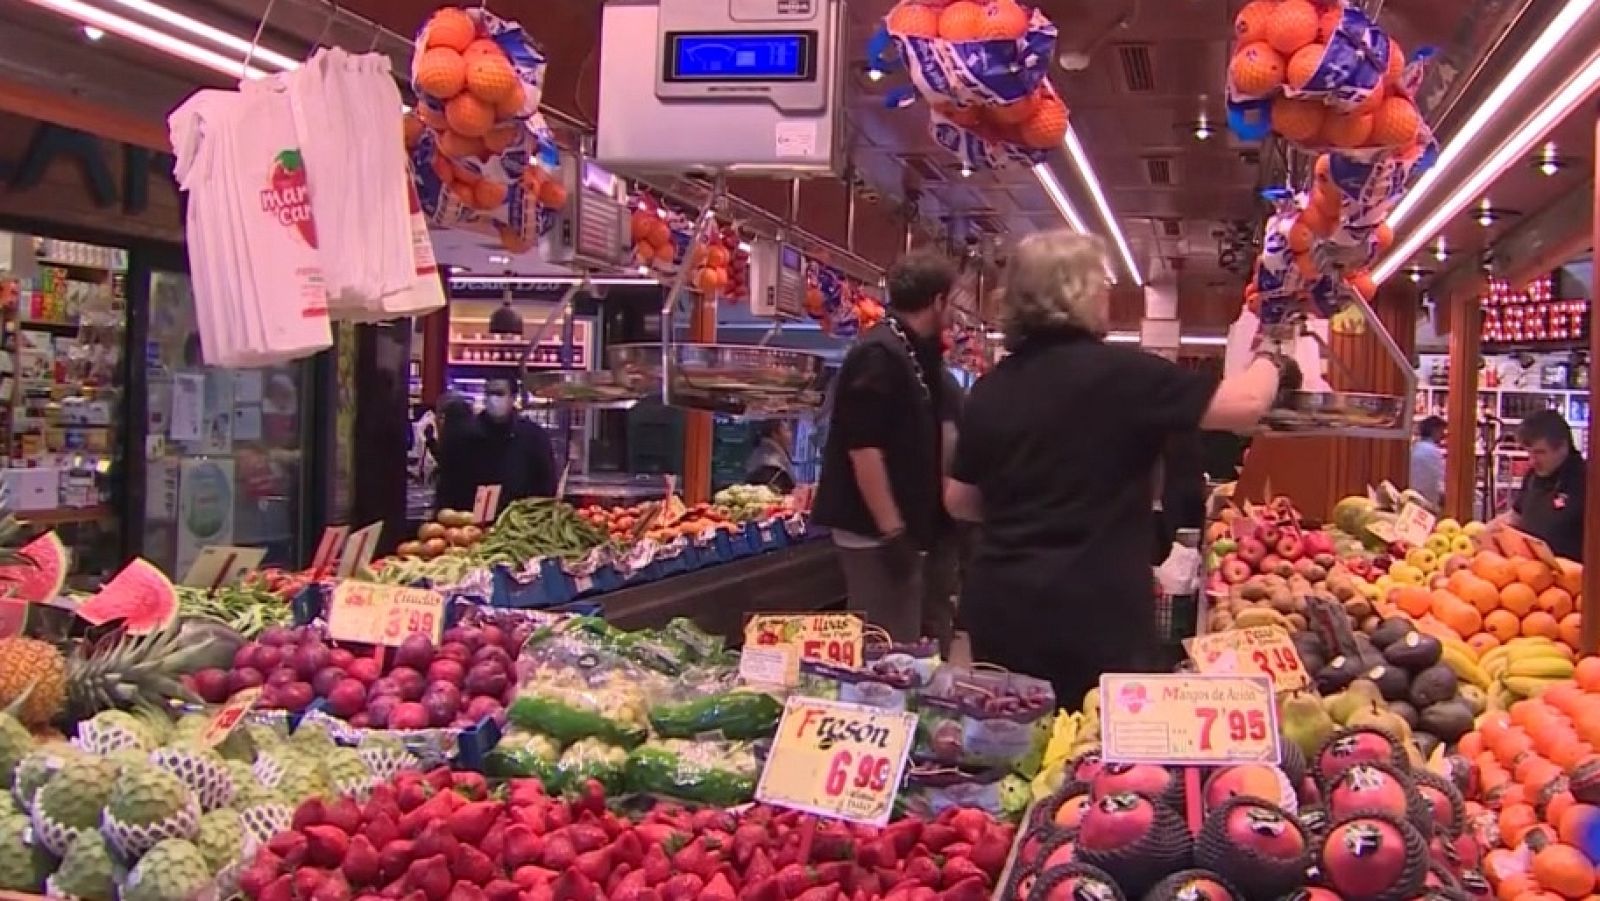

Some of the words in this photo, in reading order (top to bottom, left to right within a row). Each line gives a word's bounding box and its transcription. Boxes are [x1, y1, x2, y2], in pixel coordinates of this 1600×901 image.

[259, 185, 309, 212] mar
[279, 203, 313, 226] car
[1481, 302, 1587, 341] ARKET
